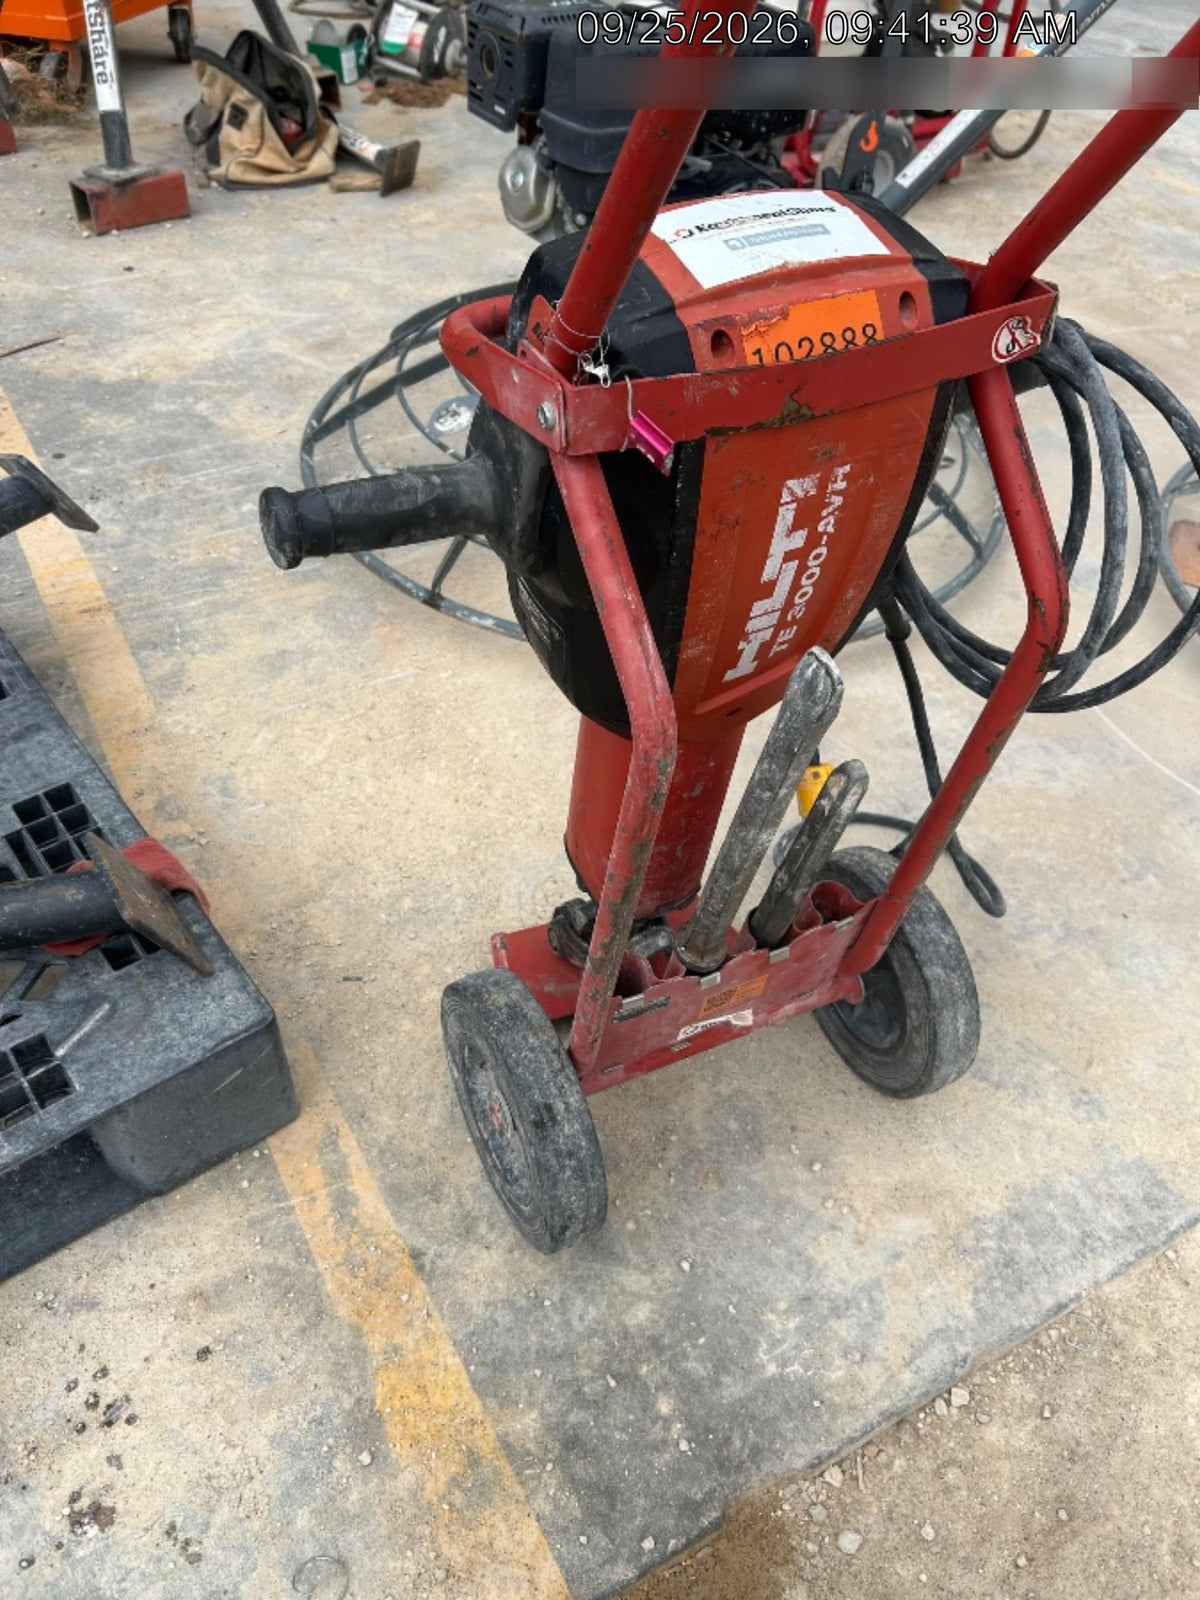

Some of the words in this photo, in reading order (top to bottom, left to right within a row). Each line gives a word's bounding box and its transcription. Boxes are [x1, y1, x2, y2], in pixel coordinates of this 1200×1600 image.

[721, 473, 821, 683] HILTI
[768, 625, 797, 658] TE
[787, 464, 851, 621] 3000-AVH
